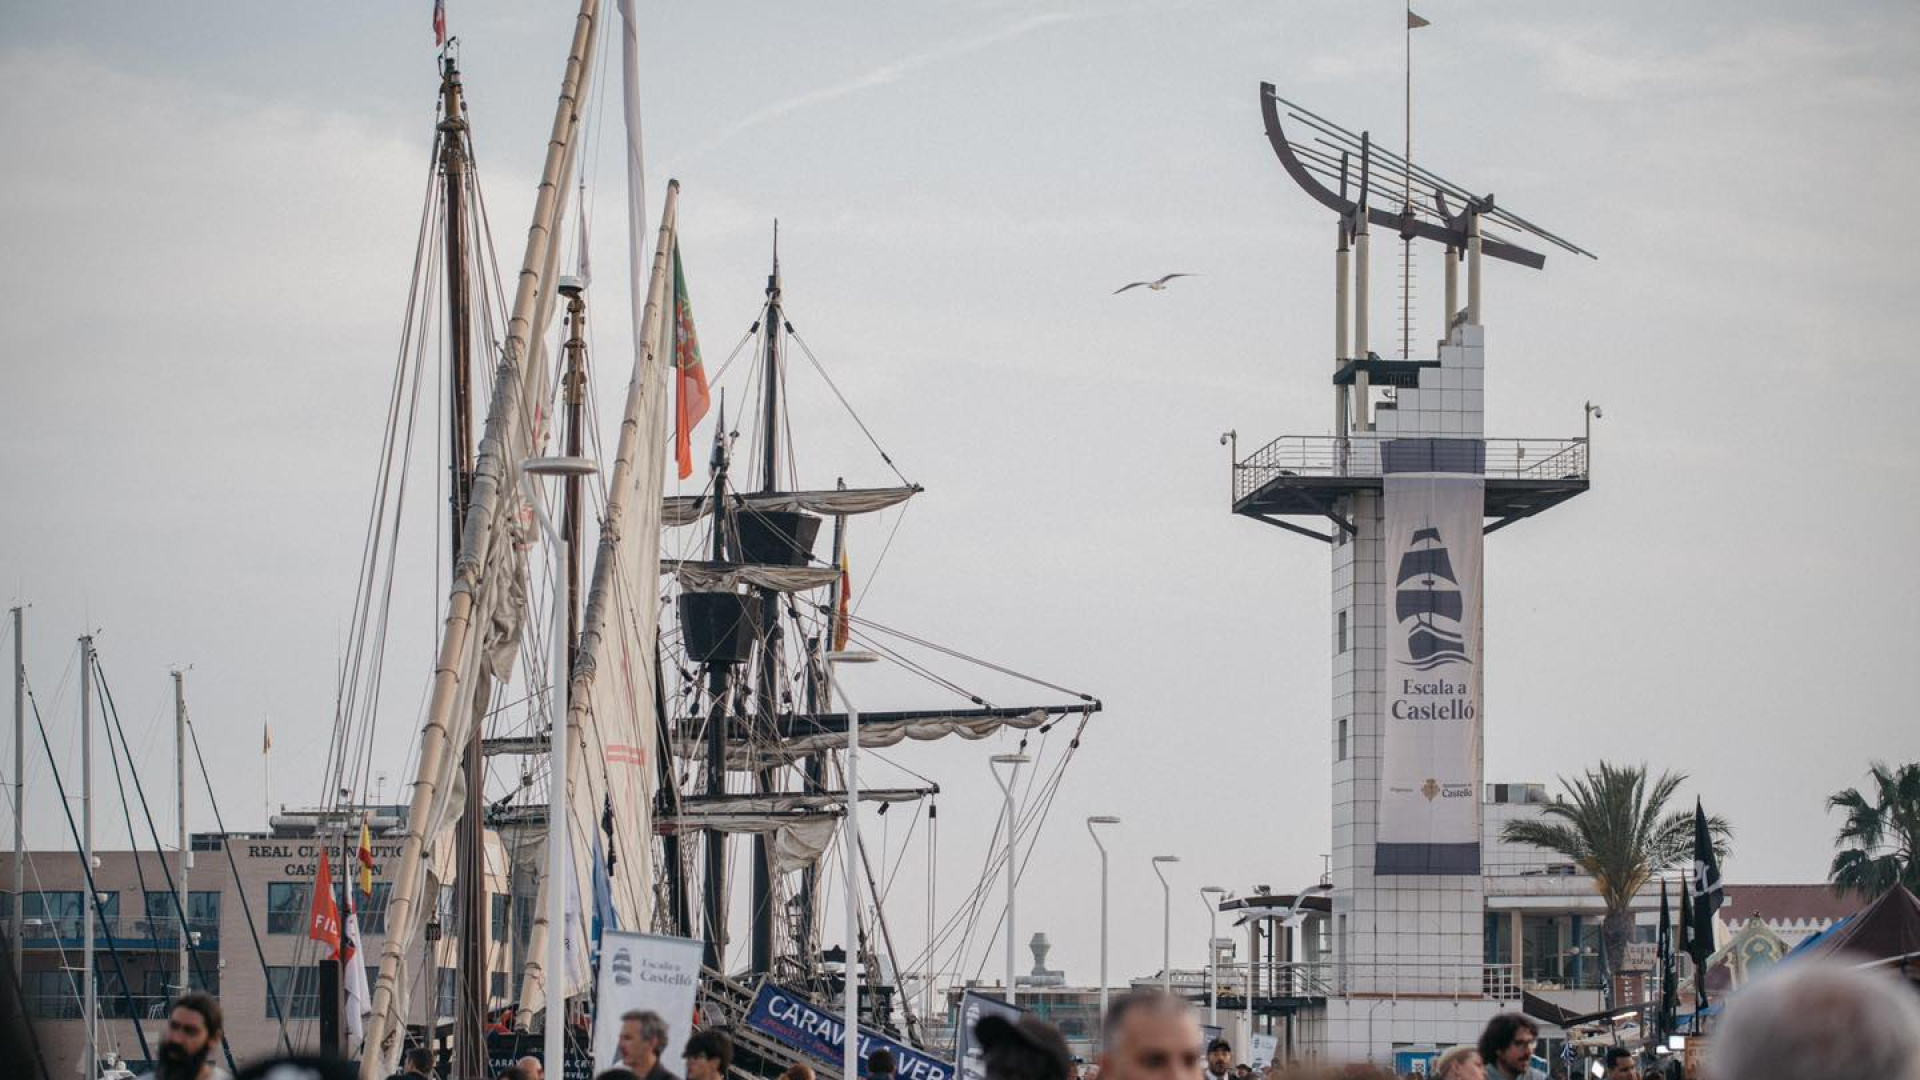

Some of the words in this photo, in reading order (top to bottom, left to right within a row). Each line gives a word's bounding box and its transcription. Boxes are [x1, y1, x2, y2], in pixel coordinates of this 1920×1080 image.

[1403, 679, 1453, 694] Escala
[1458, 683, 1466, 694] a
[1391, 699, 1474, 720] Castelló
[249, 846, 292, 857] REAL
